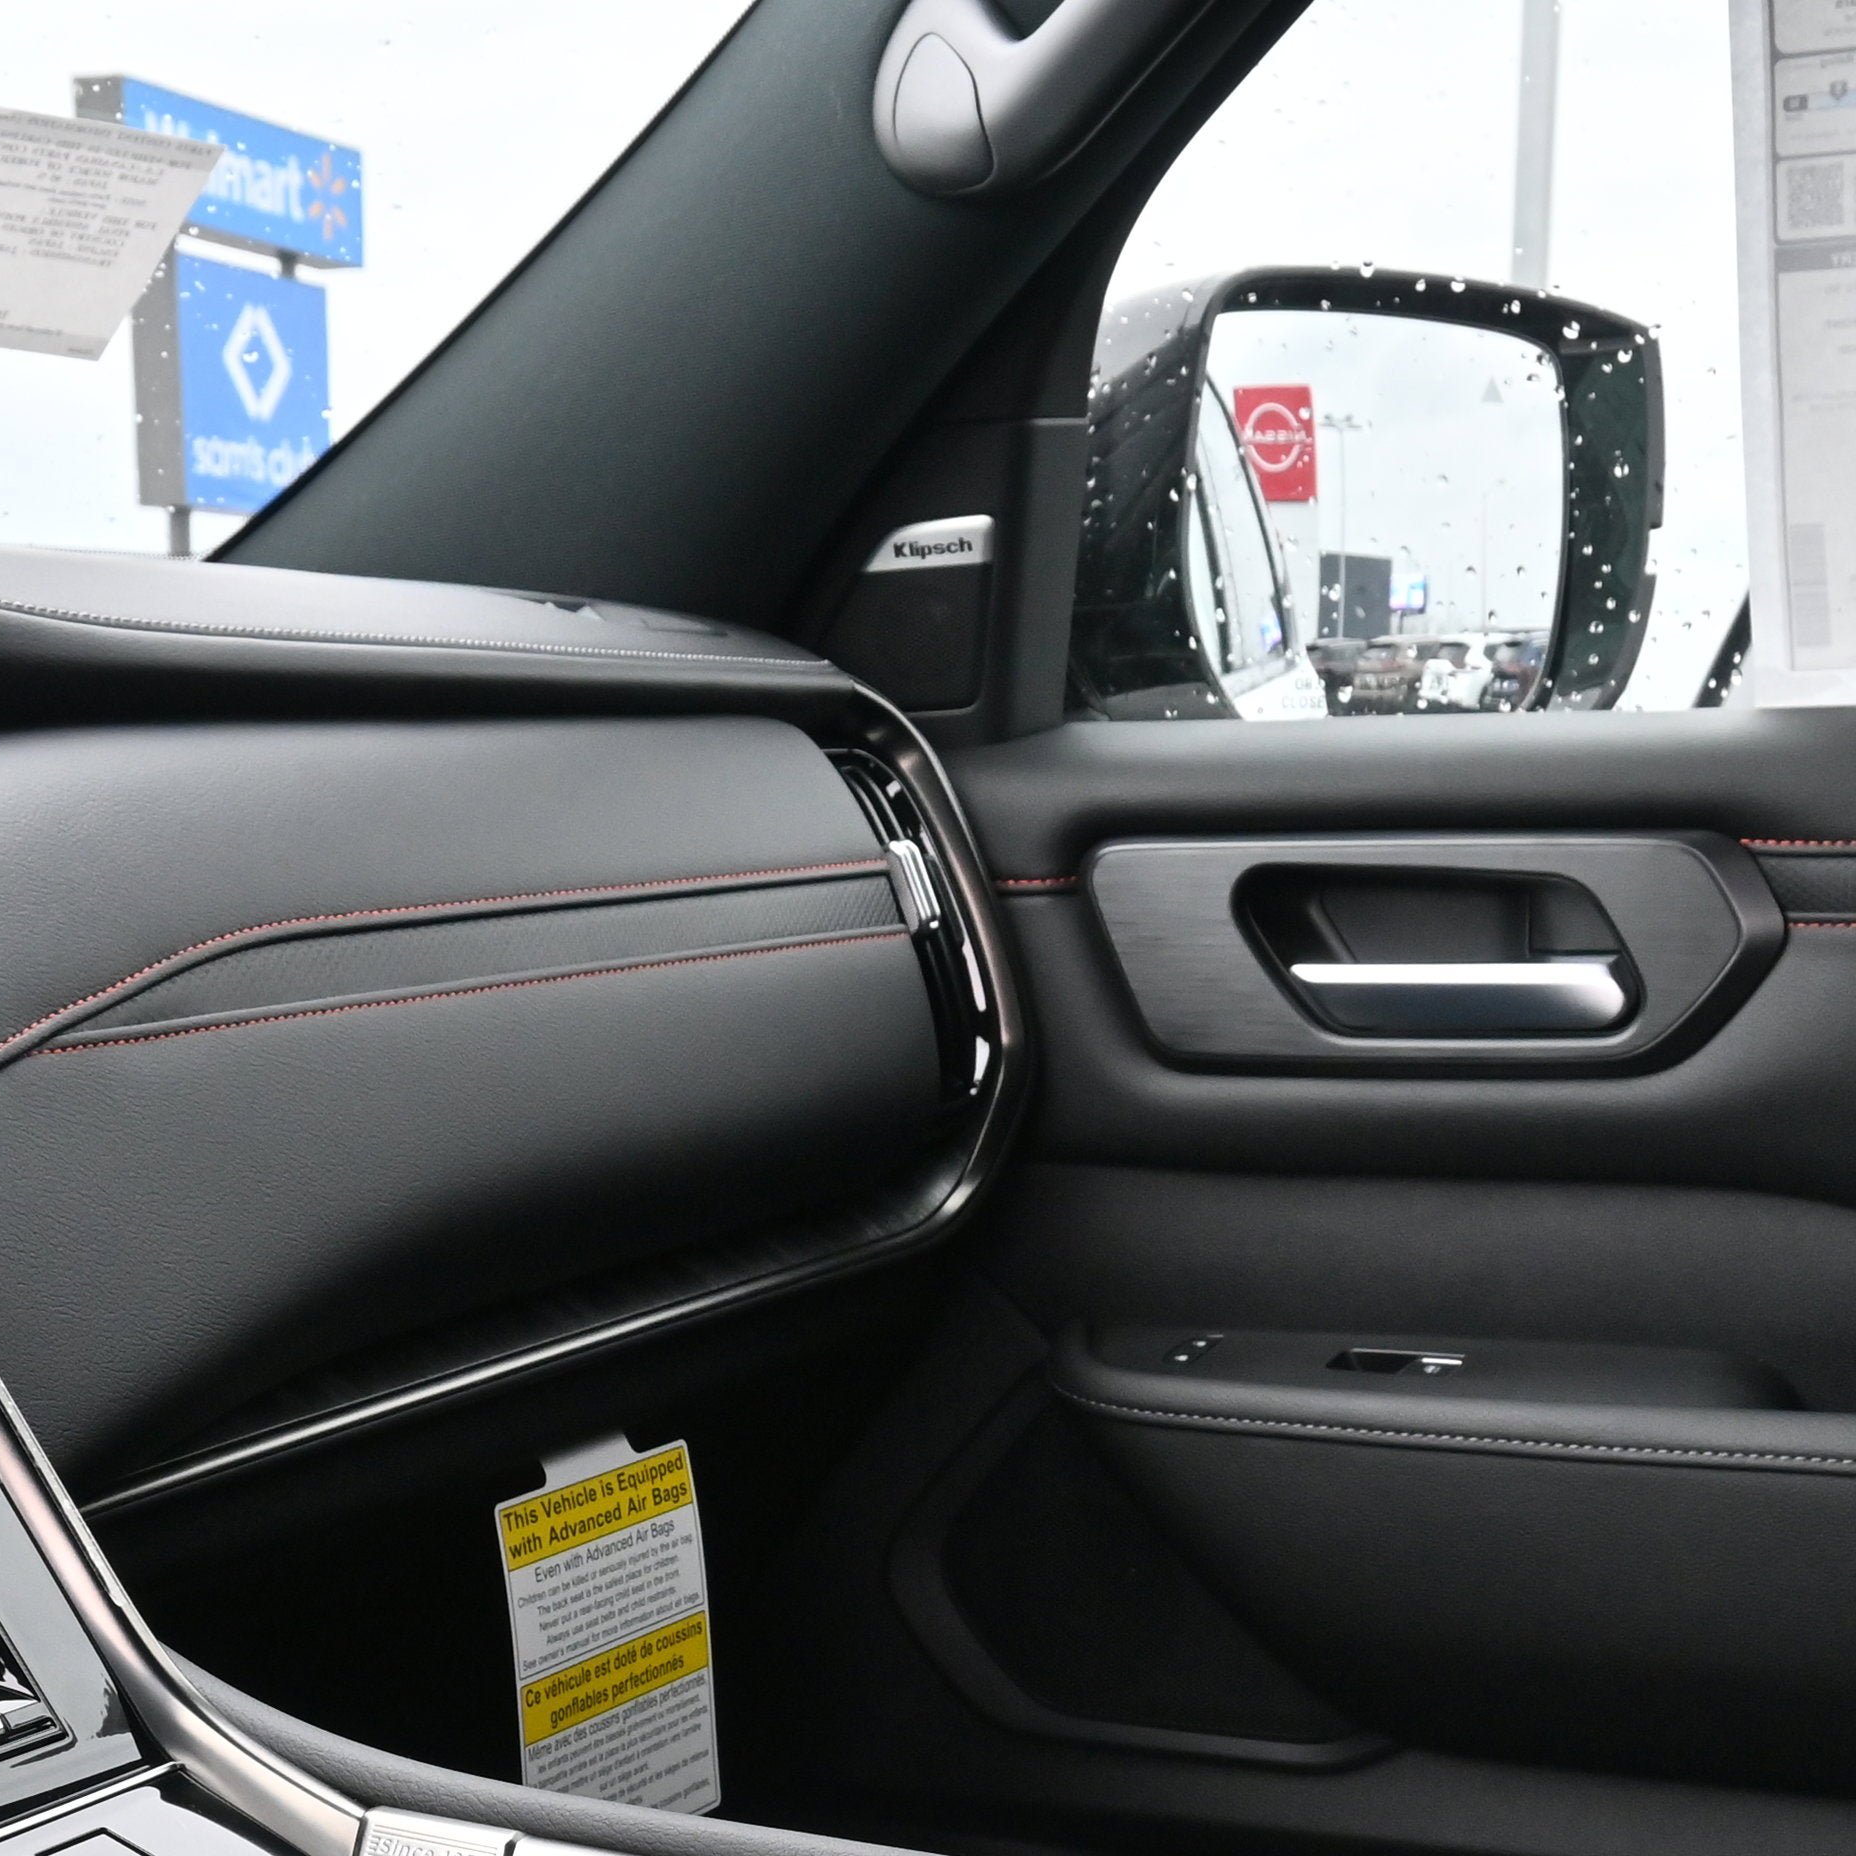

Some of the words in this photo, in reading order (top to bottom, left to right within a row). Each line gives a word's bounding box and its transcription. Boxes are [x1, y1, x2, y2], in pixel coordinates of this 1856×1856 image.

[893, 537, 973, 560] Klipsch
[502, 1508, 539, 1533] This
[541, 1487, 597, 1518] Vehicle
[600, 1479, 615, 1498] is
[617, 1452, 684, 1492] Equipped
[508, 1533, 542, 1560] with
[548, 1509, 622, 1546] Advanced
[627, 1495, 648, 1517] Air
[652, 1481, 687, 1507] Bags
[535, 1561, 561, 1583] Even
[564, 1552, 584, 1572] with
[585, 1533, 634, 1565] Advanced
[636, 1528, 650, 1544] Air
[650, 1519, 675, 1541] Bags
[525, 1687, 541, 1708] Ce
[544, 1663, 592, 1700] véhicule
[594, 1659, 612, 1679] est
[613, 1644, 637, 1668] doté
[640, 1639, 653, 1660] de
[656, 1619, 703, 1652] coussins
[550, 1687, 609, 1729] gonflables
[611, 1654, 684, 1700] perfectionnés
